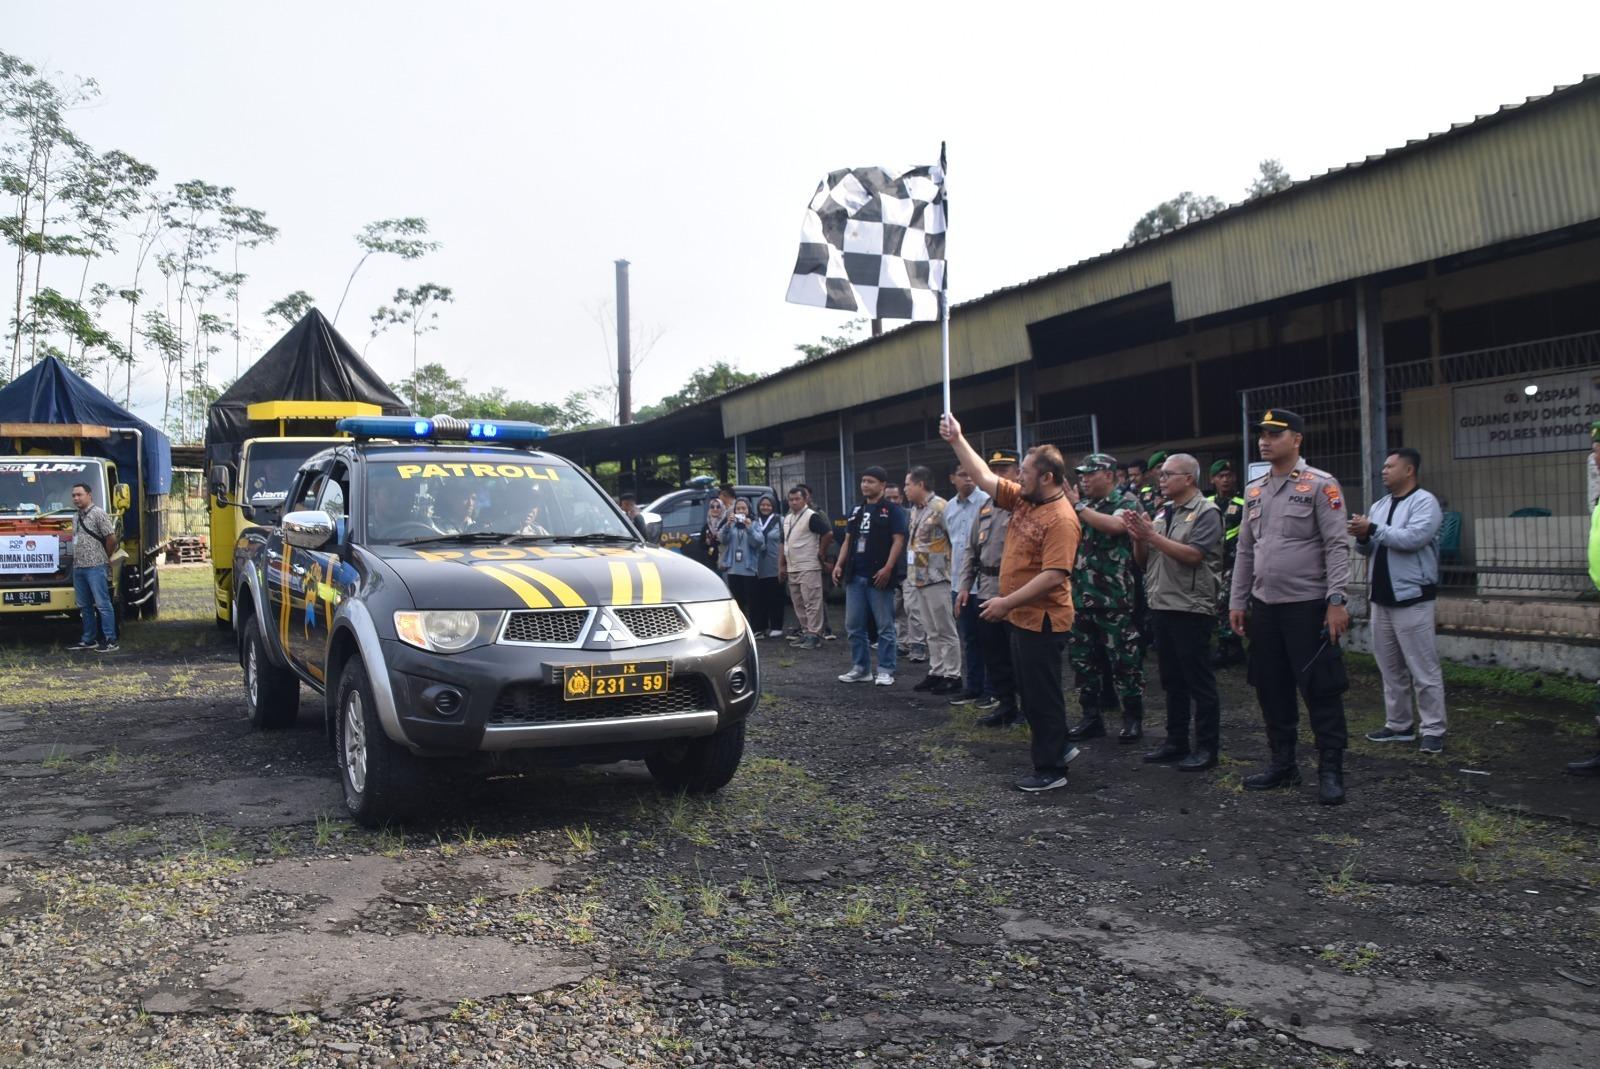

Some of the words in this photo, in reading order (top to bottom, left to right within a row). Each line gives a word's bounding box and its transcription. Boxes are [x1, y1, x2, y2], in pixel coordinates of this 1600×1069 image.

[1460, 413, 1510, 428] GUDANG
[1513, 409, 1538, 423] KPU
[1541, 405, 1581, 420] OMPC
[1489, 428, 1537, 443] POLRES
[1540, 423, 1591, 438] WONOS
[397, 463, 560, 481] PATROLI
[23, 554, 54, 563] LOGISTIK
[5, 592, 14, 601] AA
[596, 677, 625, 694] 231
[642, 675, 663, 691] 59
